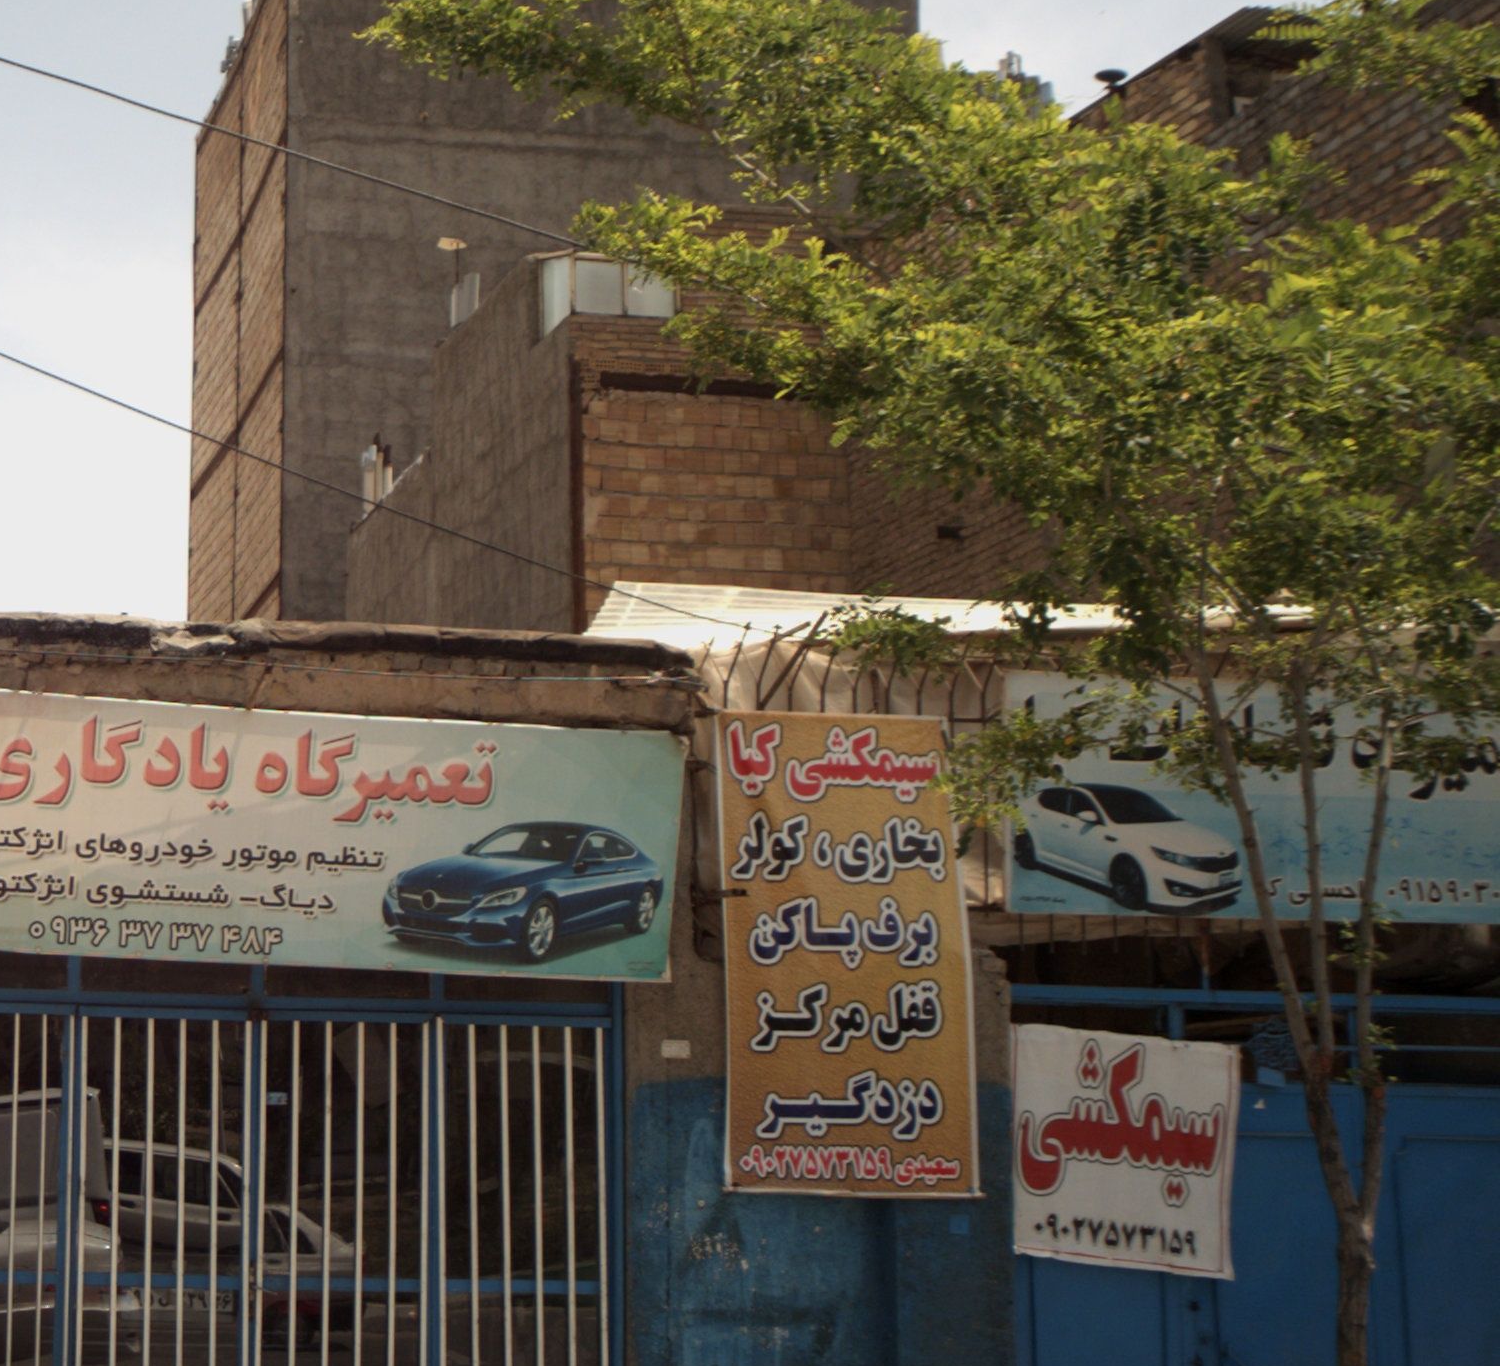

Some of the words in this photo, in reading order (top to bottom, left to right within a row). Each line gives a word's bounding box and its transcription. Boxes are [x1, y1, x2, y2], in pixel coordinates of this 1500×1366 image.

[255, 728, 498, 823] تعمیرگاه
[727, 721, 780, 795] کیا
[786, 727, 942, 802] سیمکشی
[75, 831, 214, 862] خودروهای
[222, 845, 297, 869] موتور
[306, 844, 386, 875] تنظیم
[731, 810, 809, 880] کولر
[86, 878, 230, 907] شستشوی
[750, 896, 863, 969] پاکن
[863, 895, 938, 966] برف
[751, 985, 867, 1053] مرکز
[872, 981, 942, 1052] قفل
[757, 1072, 943, 1139] دزدگیر
[1018, 1039, 1226, 1206] سیمکشی
[895, 1154, 961, 1187] سعیدی
[1034, 1213, 1197, 1256] ۰۹۰۲۷۵۷۳۱۵۹
